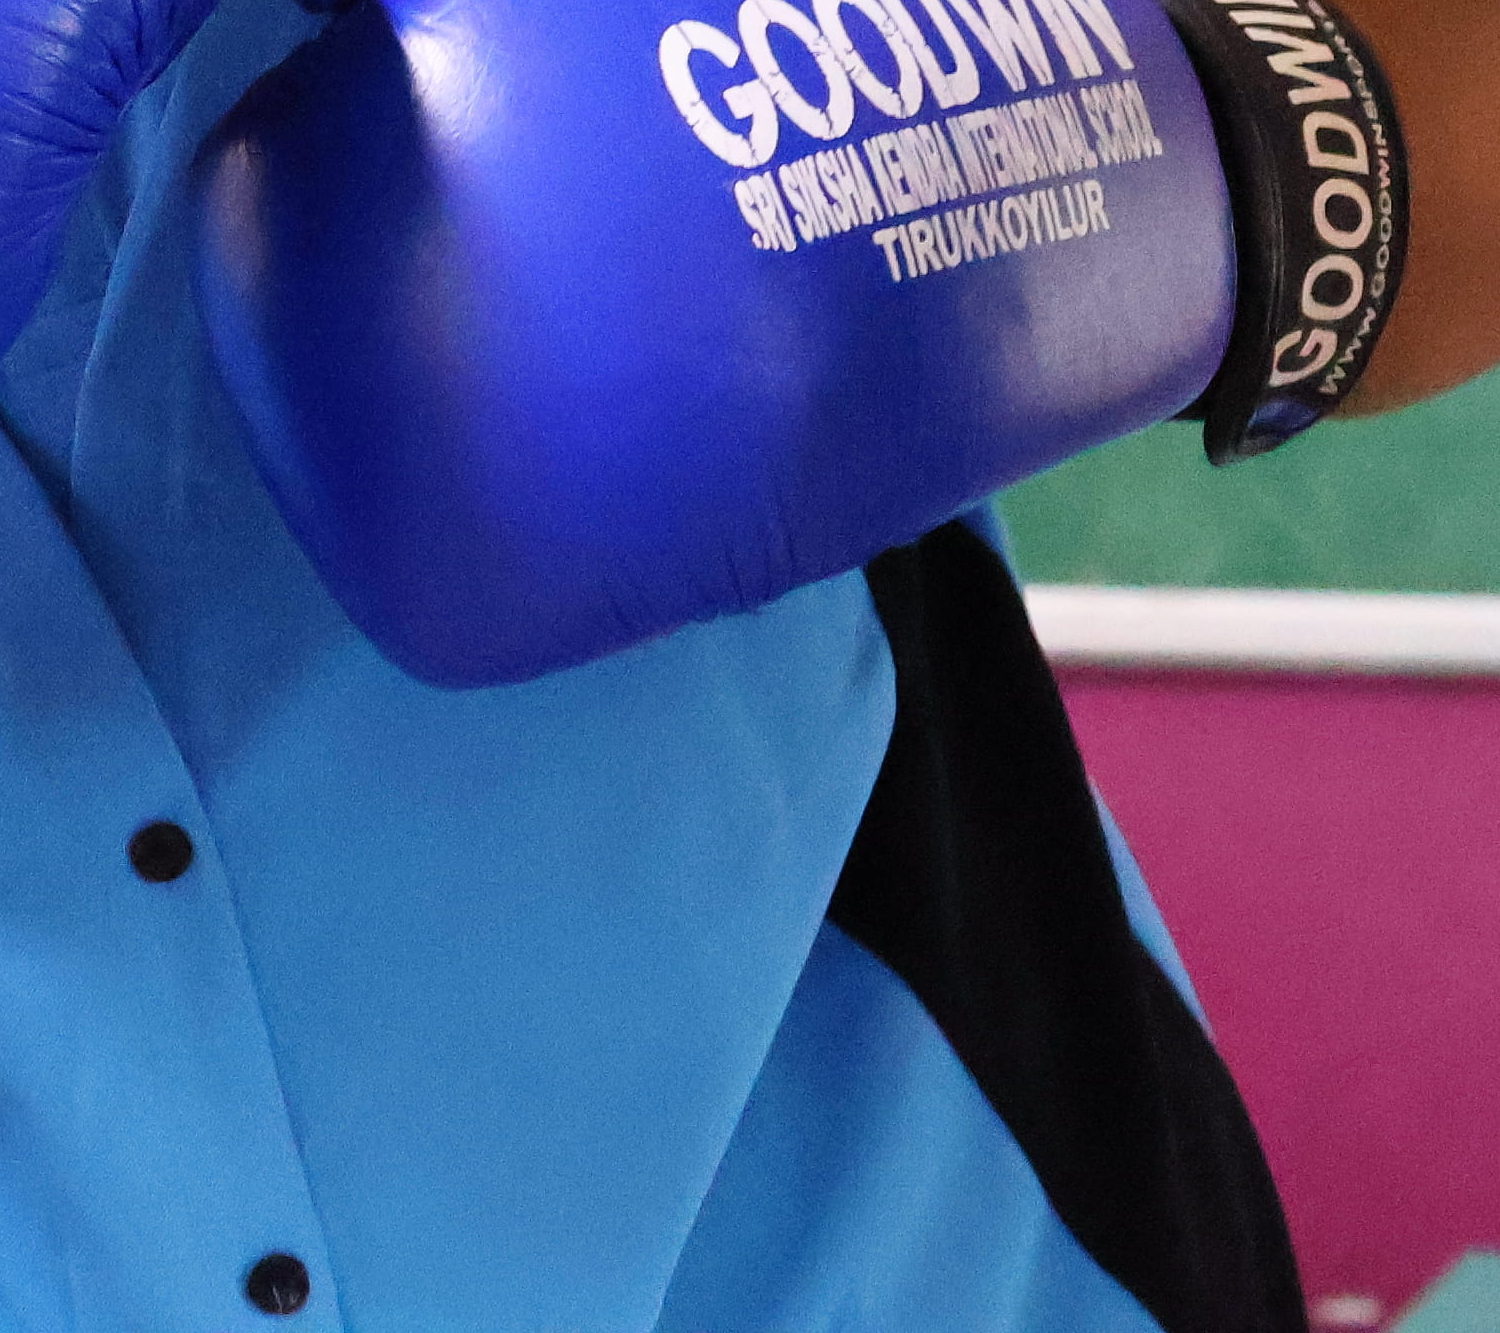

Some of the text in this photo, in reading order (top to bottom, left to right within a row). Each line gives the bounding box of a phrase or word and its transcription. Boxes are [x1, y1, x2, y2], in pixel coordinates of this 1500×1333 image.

[733, 169, 797, 252] SRI
[778, 143, 884, 244] SIKSHA
[872, 179, 1111, 283] TIRUKKOYILUR
